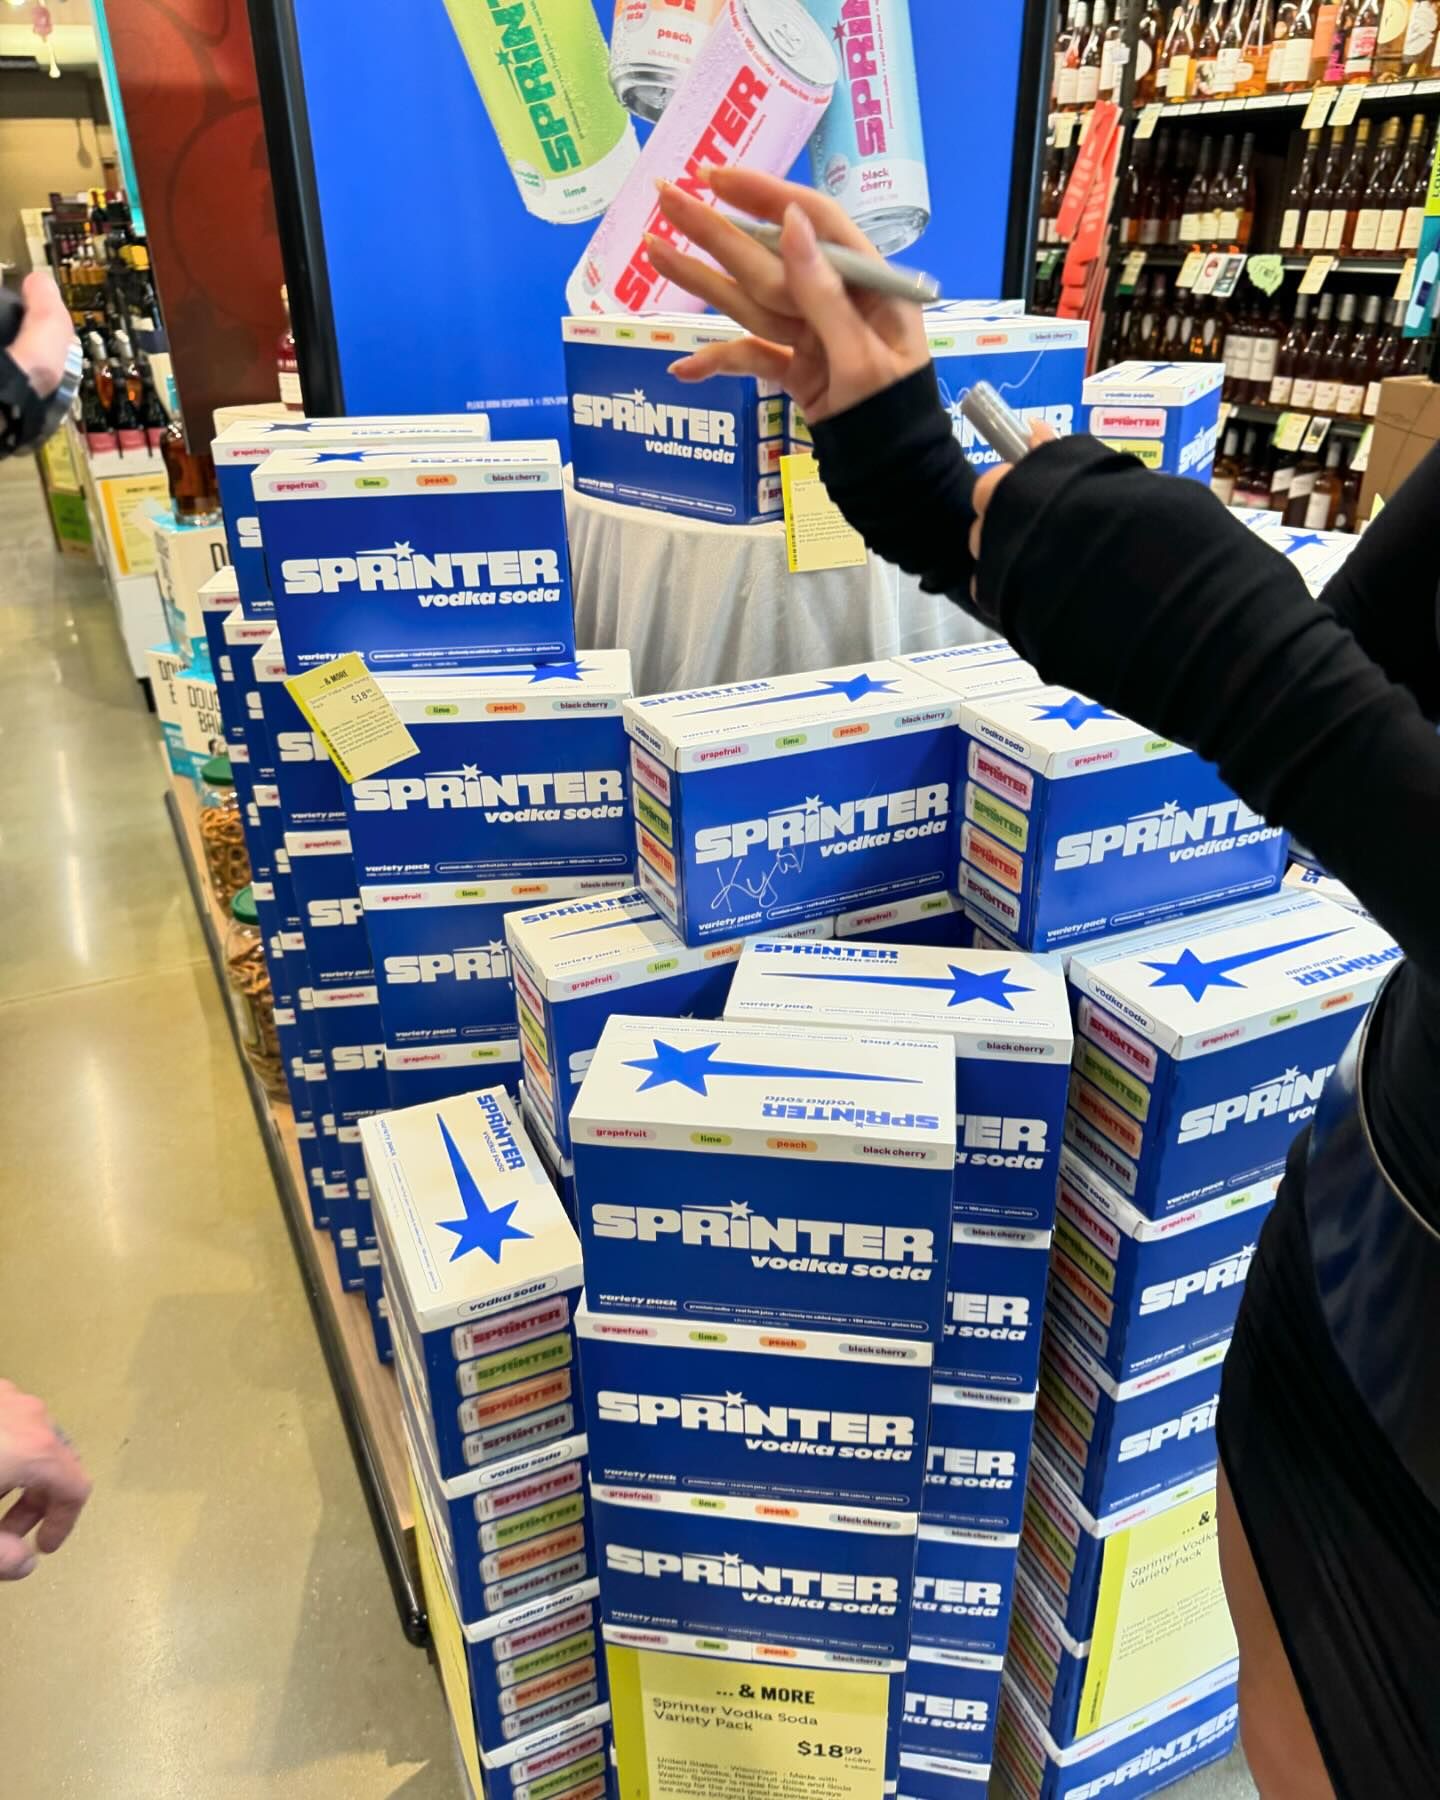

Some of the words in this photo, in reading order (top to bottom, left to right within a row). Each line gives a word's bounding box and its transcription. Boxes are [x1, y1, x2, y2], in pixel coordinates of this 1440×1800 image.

[657, 27, 693, 45] peach
[486, 0, 581, 173] SPRIN
[862, 168, 889, 181] black
[563, 186, 587, 198] lime
[860, 179, 893, 193] cherry
[645, 439, 692, 458] vodka
[693, 447, 735, 464] soda
[276, 480, 320, 492] grapefruit
[362, 478, 381, 488] lime
[424, 475, 449, 485] peach
[492, 473, 515, 484] black
[515, 472, 542, 482] cherry
[418, 591, 496, 608] vodka
[498, 587, 561, 603] soda
[432, 705, 450, 714] lime
[494, 703, 518, 713] peach
[560, 701, 581, 711] black
[581, 699, 608, 710] cherry
[700, 746, 742, 761] grapefruit
[783, 737, 800, 746] lime
[840, 725, 863, 736] peach
[901, 714, 922, 725] black
[922, 710, 946, 722] cherry
[980, 724, 1004, 742] vodka
[1004, 738, 1025, 753] soda
[1074, 751, 1114, 767] grapefruit
[485, 807, 560, 823] vodka
[563, 804, 624, 820] soda
[304, 839, 342, 849] grapefruit
[820, 831, 891, 858] vodka
[892, 819, 948, 843] soda
[1168, 839, 1235, 863] vodka
[365, 864, 403, 874] variety
[404, 862, 431, 872] pack
[382, 893, 422, 902] grapefruit
[699, 917, 736, 931] variety
[737, 911, 763, 922] pack
[856, 911, 893, 926] grapefruit
[1046, 923, 1083, 938] variety
[1083, 916, 1108, 930] pack
[571, 974, 613, 990] grapefruit
[654, 961, 671, 972] lime
[712, 945, 734, 957] peach
[821, 954, 857, 962] vodka
[739, 1000, 784, 1010] variety
[786, 1002, 813, 1010] pack
[1095, 985, 1124, 1010] vodka
[1123, 1005, 1148, 1027] soda
[1201, 1028, 1241, 1047] grapefruit
[986, 1041, 1012, 1051] black
[1012, 1043, 1045, 1055] cherry
[403, 1053, 441, 1063] grapefruit
[764, 1095, 804, 1104] soda
[805, 1098, 856, 1106] vodka
[596, 1127, 648, 1140] grapefruit
[700, 1134, 722, 1144] lime
[776, 1140, 808, 1151] peach
[862, 1146, 893, 1155] black
[893, 1148, 928, 1160] cherry
[969, 1153, 1045, 1170] soda
[1159, 1212, 1197, 1231] grapefruit
[972, 1228, 994, 1238] black
[994, 1230, 1026, 1241] cherry
[751, 1254, 849, 1276] vodka
[850, 1263, 932, 1281] soda
[469, 1293, 512, 1312] vodka
[513, 1282, 547, 1298] soda
[599, 1294, 645, 1306] variety
[645, 1298, 678, 1307] pack
[601, 1326, 649, 1337] grapefruit
[698, 1333, 718, 1342] lime
[768, 1338, 798, 1349] peach
[847, 1345, 874, 1355] black
[874, 1347, 907, 1359] cherry
[958, 1326, 1027, 1341] soda
[745, 1438, 835, 1458] vodka
[837, 1446, 913, 1463] soda
[490, 1462, 529, 1480] vodka
[531, 1450, 562, 1466] soda
[603, 1468, 647, 1480] variety
[647, 1472, 678, 1482] pack
[950, 1476, 1013, 1489] soda
[609, 1490, 654, 1501] grapefruit
[763, 1506, 790, 1518] peach
[836, 1513, 864, 1524] black
[864, 1516, 893, 1530] cherry
[1198, 1510, 1211, 1527] &
[1131, 1547, 1180, 1579] Sprinter
[1182, 1533, 1218, 1552] Vodk
[1128, 1564, 1172, 1590] Variety
[1175, 1550, 1202, 1568] Pack
[742, 1591, 820, 1610] vodka
[820, 1600, 897, 1617] soda
[940, 1603, 1000, 1617] soda
[738, 1683, 755, 1700] &
[761, 1686, 816, 1705] MORE
[652, 1697, 717, 1716] Sprinter
[722, 1706, 772, 1722] Vodka
[778, 1712, 819, 1727] Soda
[653, 1709, 711, 1728] Variety
[716, 1717, 753, 1732] Pack
[930, 1717, 987, 1731] soda
